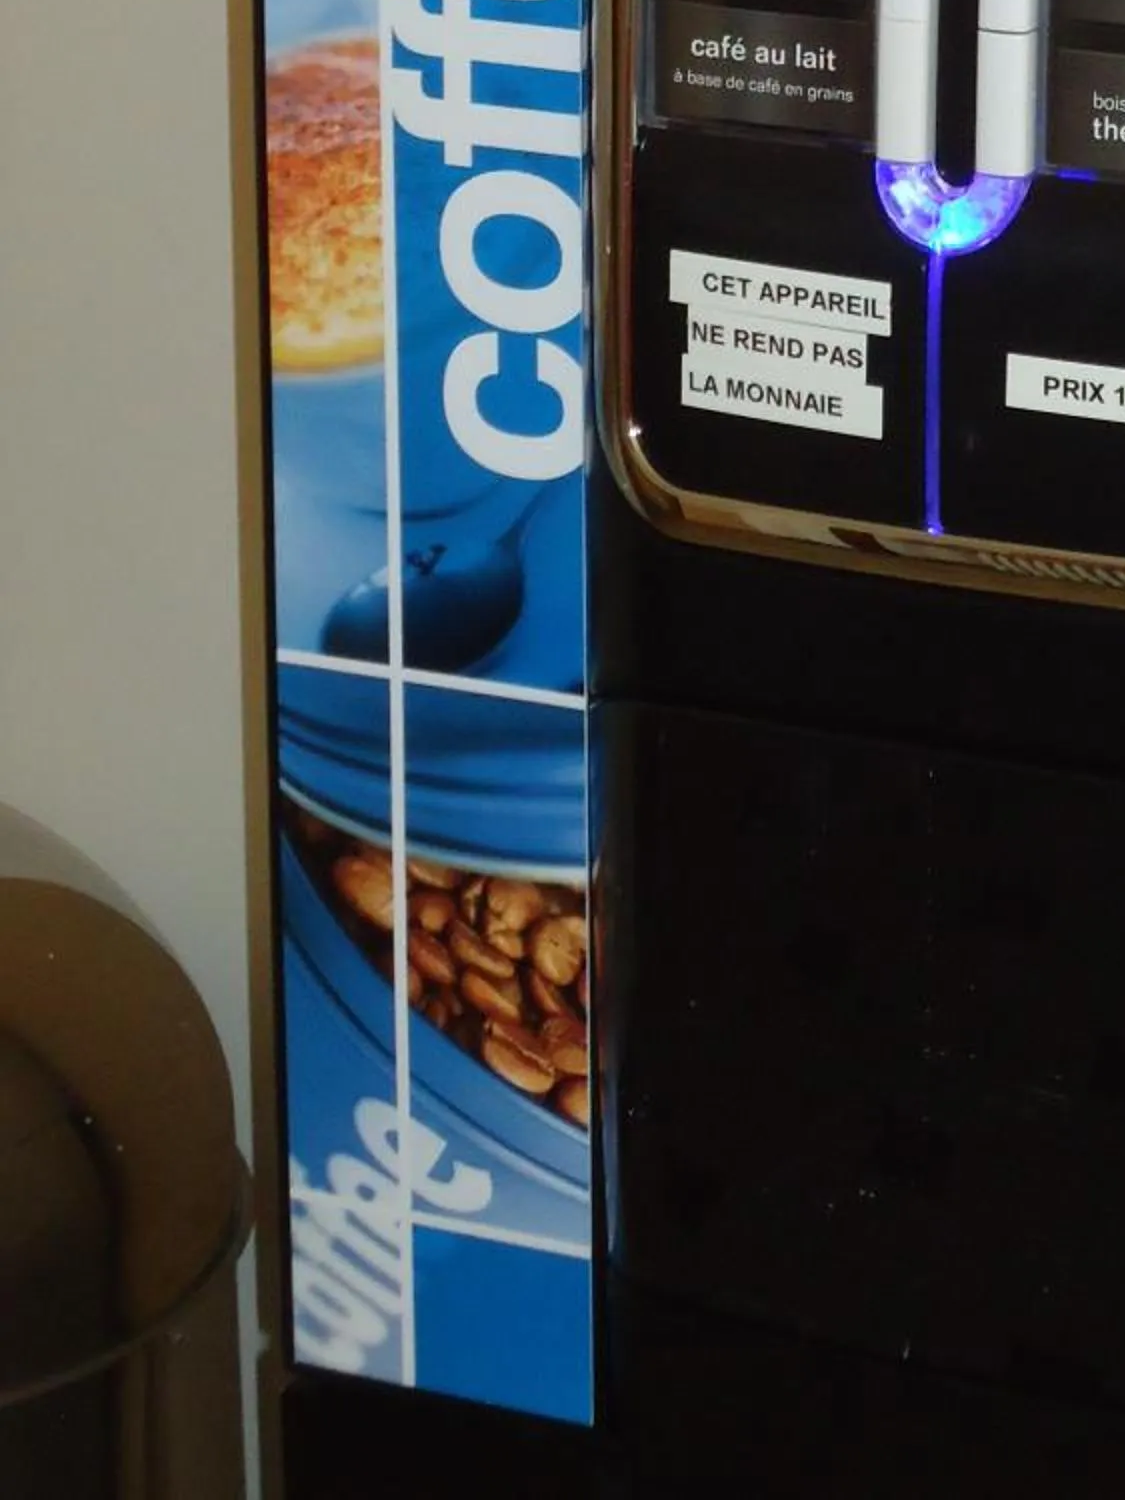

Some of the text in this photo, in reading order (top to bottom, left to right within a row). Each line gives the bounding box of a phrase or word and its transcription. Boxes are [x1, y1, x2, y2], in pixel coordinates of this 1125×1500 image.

[691, 36, 837, 72] café au lait
[673, 68, 855, 103] à base de café en grains
[702, 272, 886, 320] CET APPAREIL
[691, 321, 864, 369] NE REND PAS
[688, 371, 844, 417] LA MONNAIE
[1043, 375, 1106, 405] PRIX
